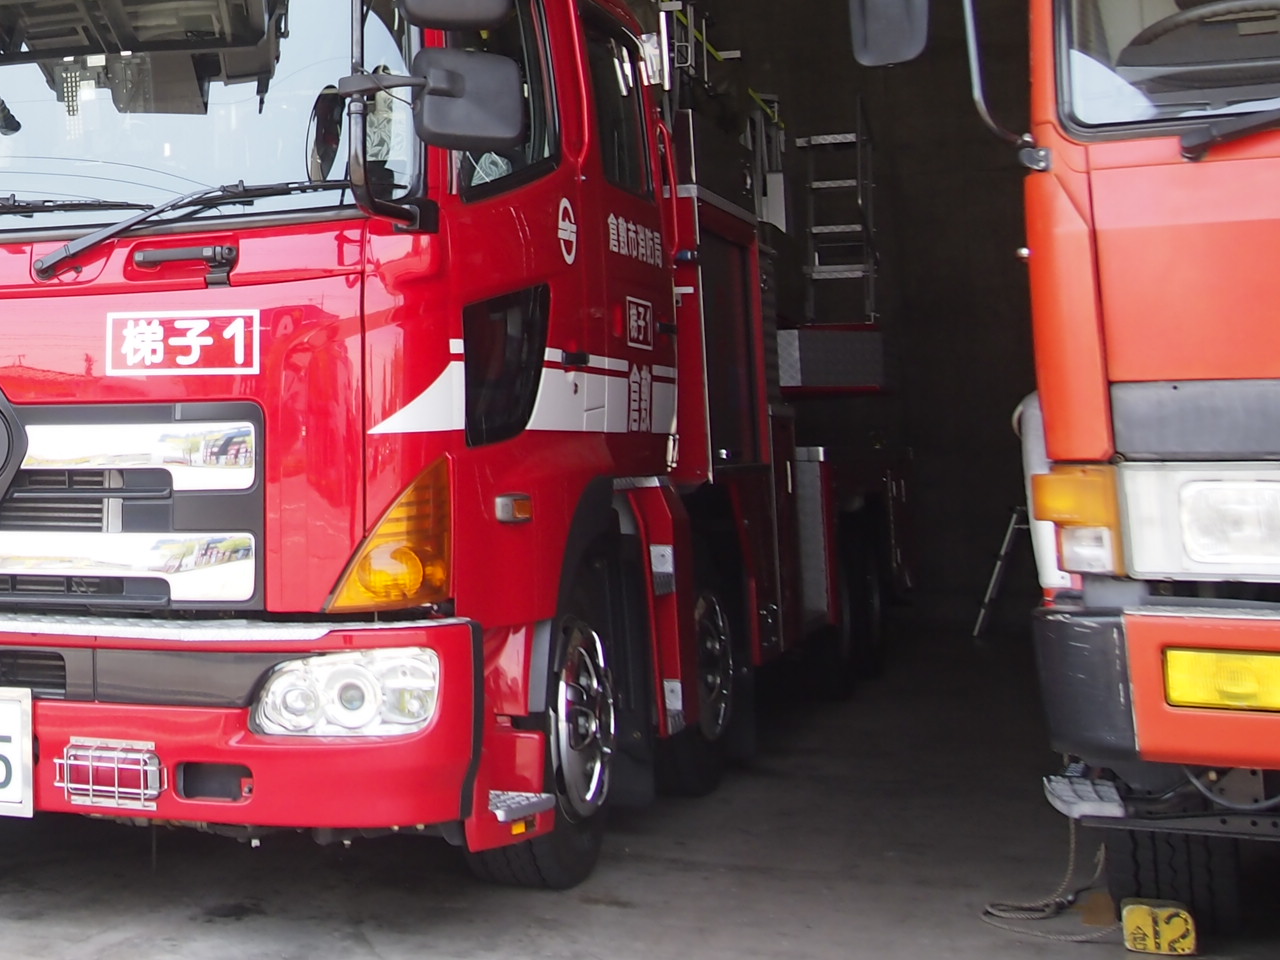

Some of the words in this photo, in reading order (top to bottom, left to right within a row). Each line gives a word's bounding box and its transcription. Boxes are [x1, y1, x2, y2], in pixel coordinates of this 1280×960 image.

[607, 212, 663, 269] 倉敷市消防局
[121, 317, 246, 367] 梯子1
